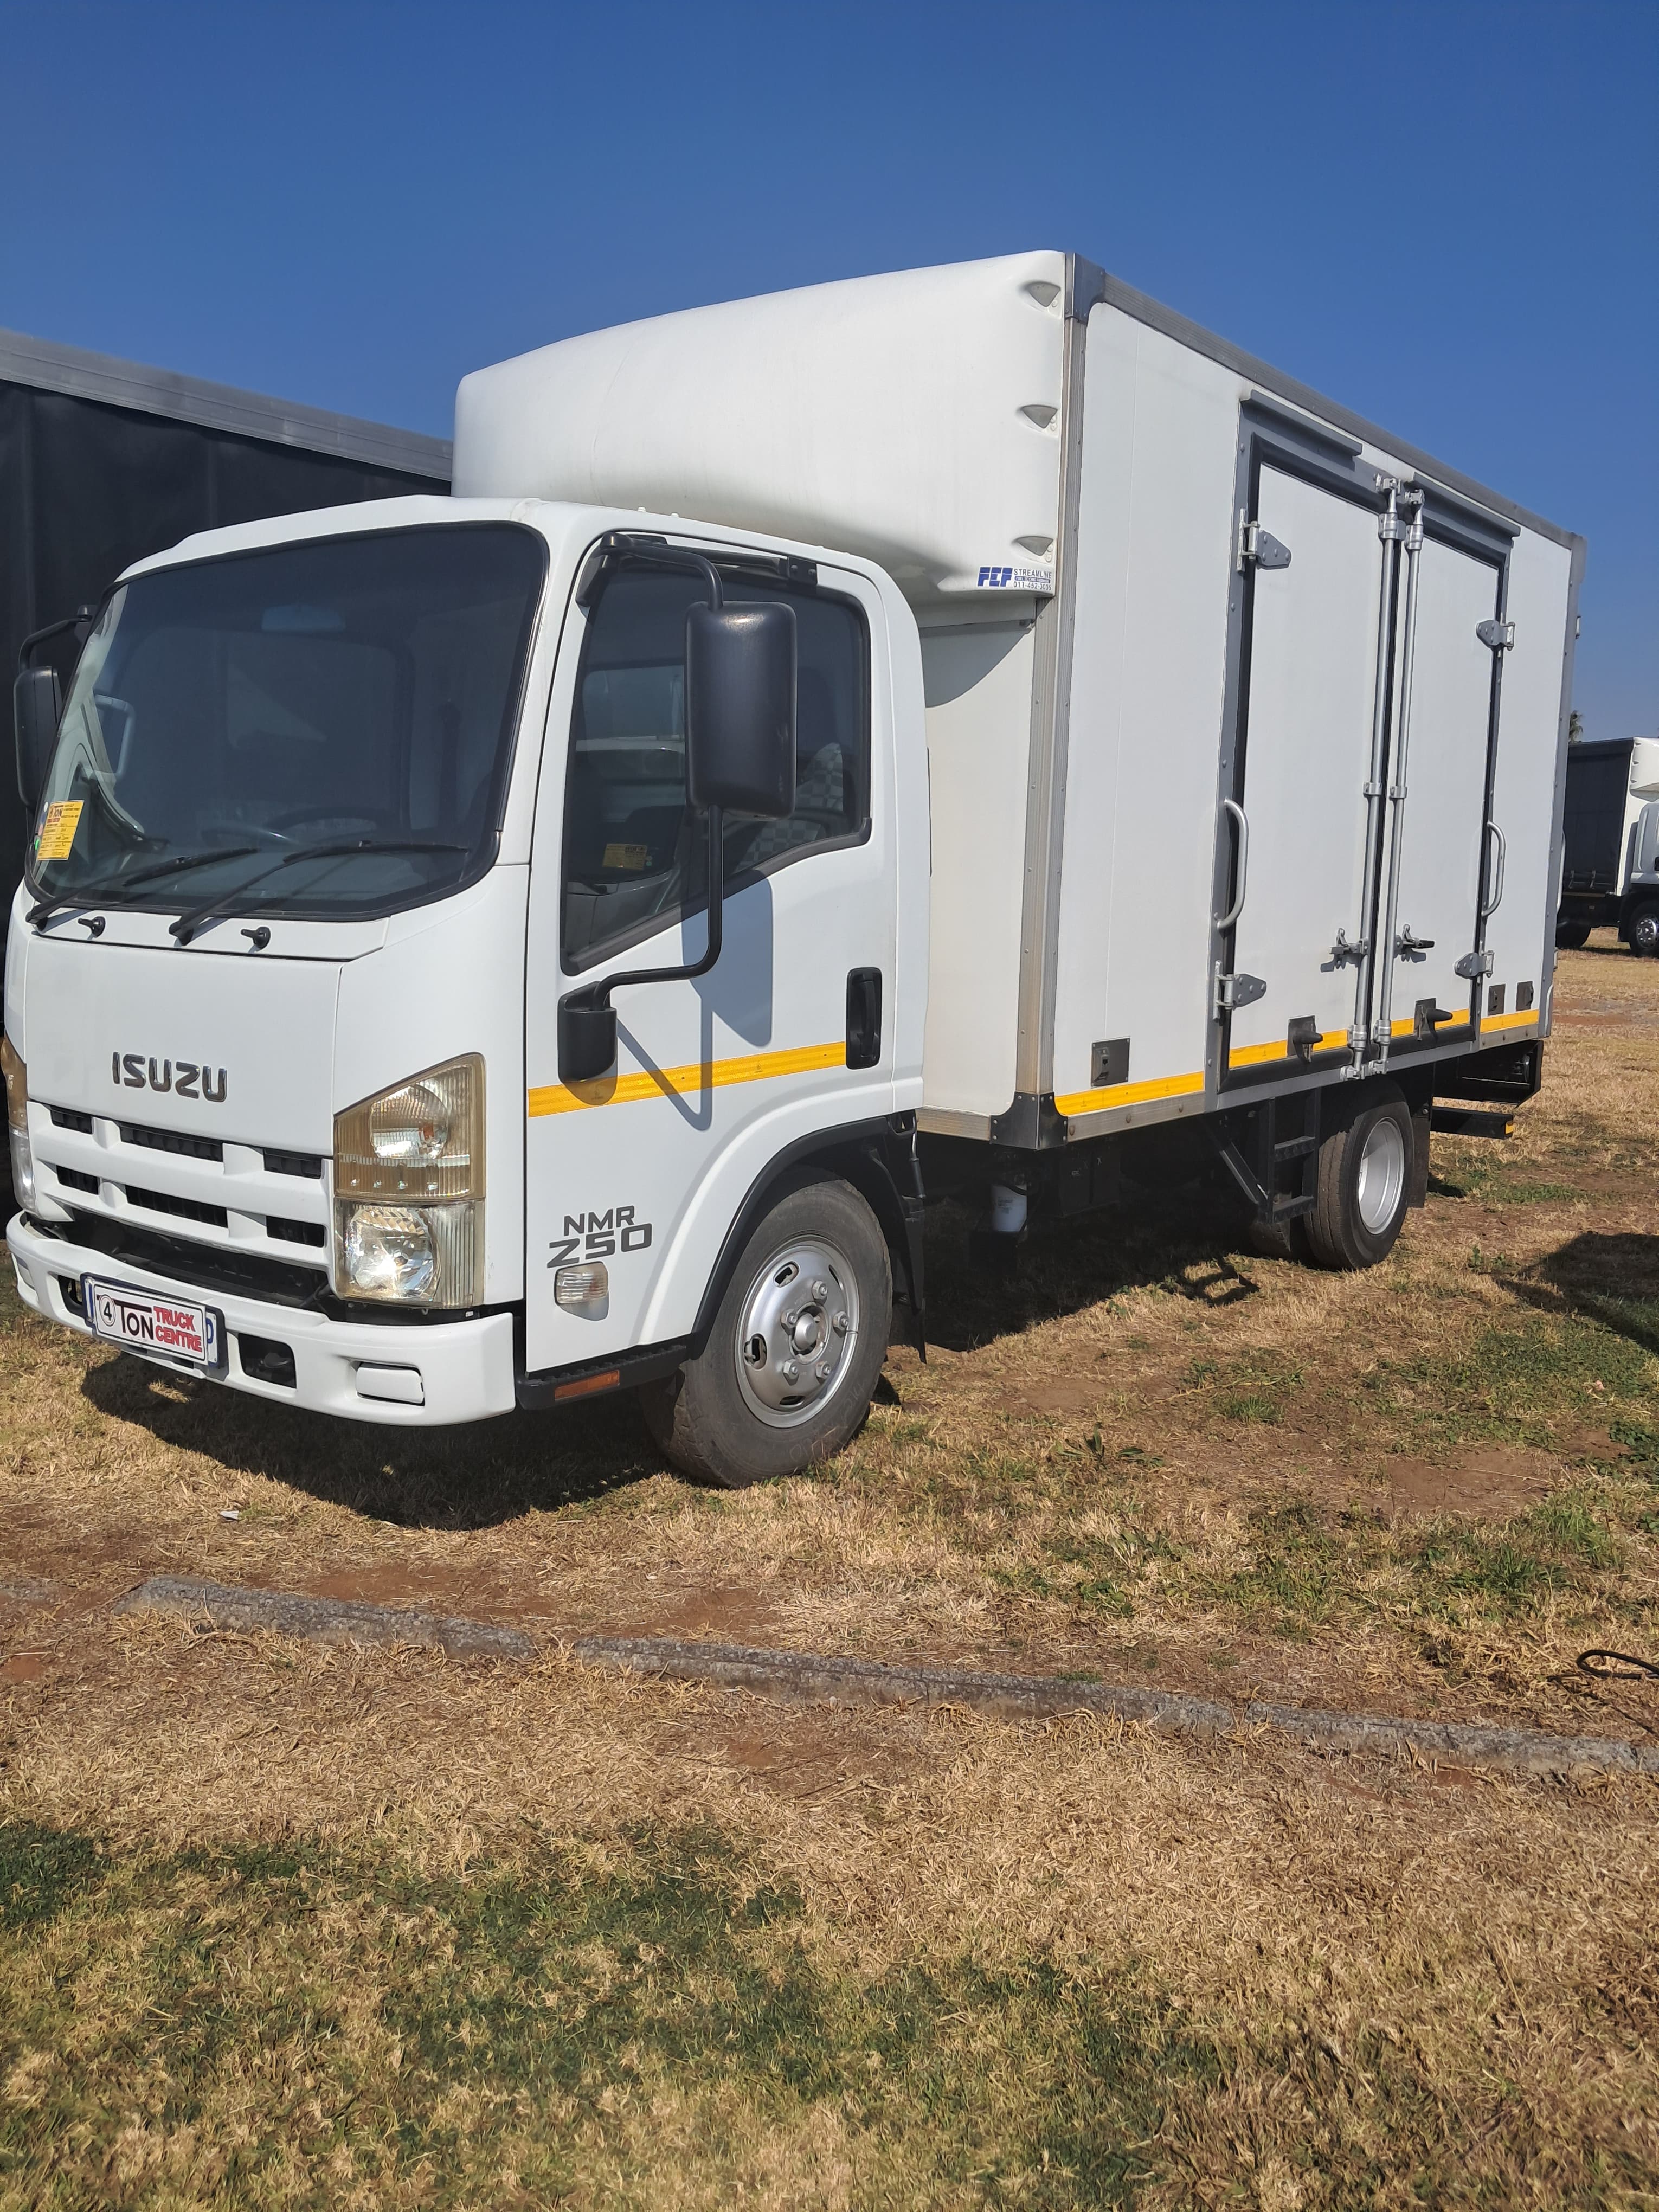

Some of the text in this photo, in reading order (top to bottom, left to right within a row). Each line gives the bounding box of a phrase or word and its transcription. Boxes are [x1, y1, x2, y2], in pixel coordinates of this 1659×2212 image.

[1014, 569, 1052, 579] STREAMLINE
[112, 1052, 227, 1103] ISUZU
[564, 1205, 634, 1236] NMR
[103, 1297, 154, 1340] 4 TON
[153, 1306, 196, 1332] TRUCK
[155, 1326, 202, 1352] CENTRE
